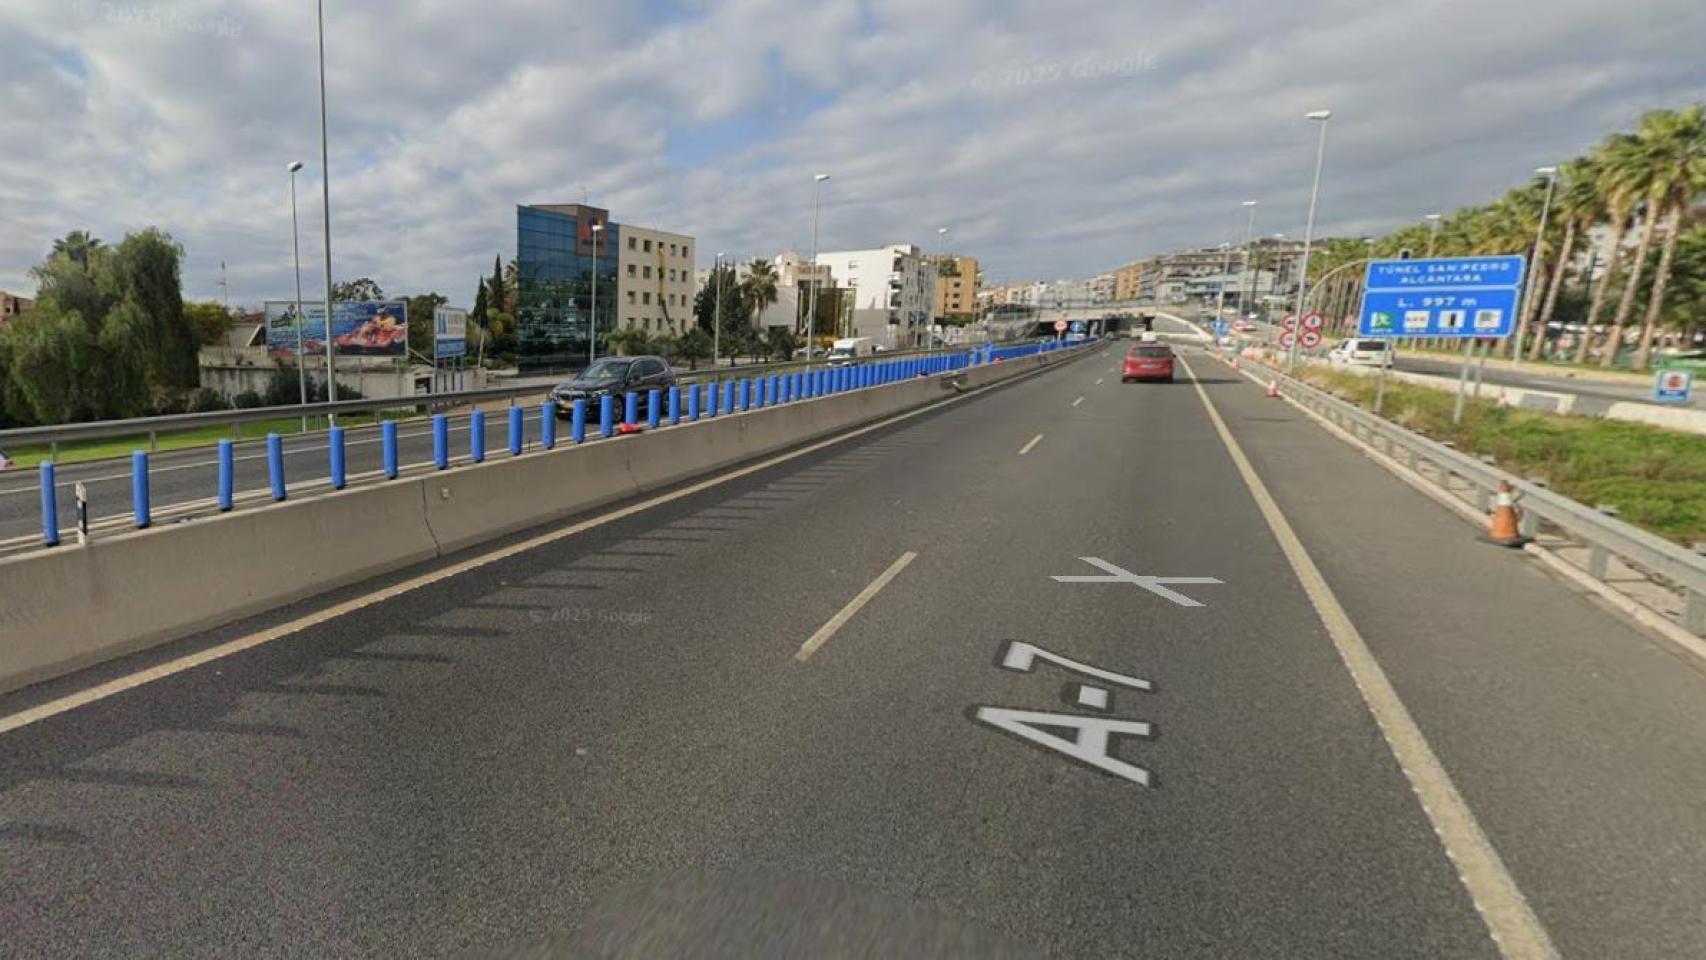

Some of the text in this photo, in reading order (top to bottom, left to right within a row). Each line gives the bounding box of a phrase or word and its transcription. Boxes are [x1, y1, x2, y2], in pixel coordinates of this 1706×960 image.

[1378, 262, 1510, 275] TÚNEL SAN PEDRO
[1422, 297, 1456, 307] 997
[1461, 298, 1477, 307] m
